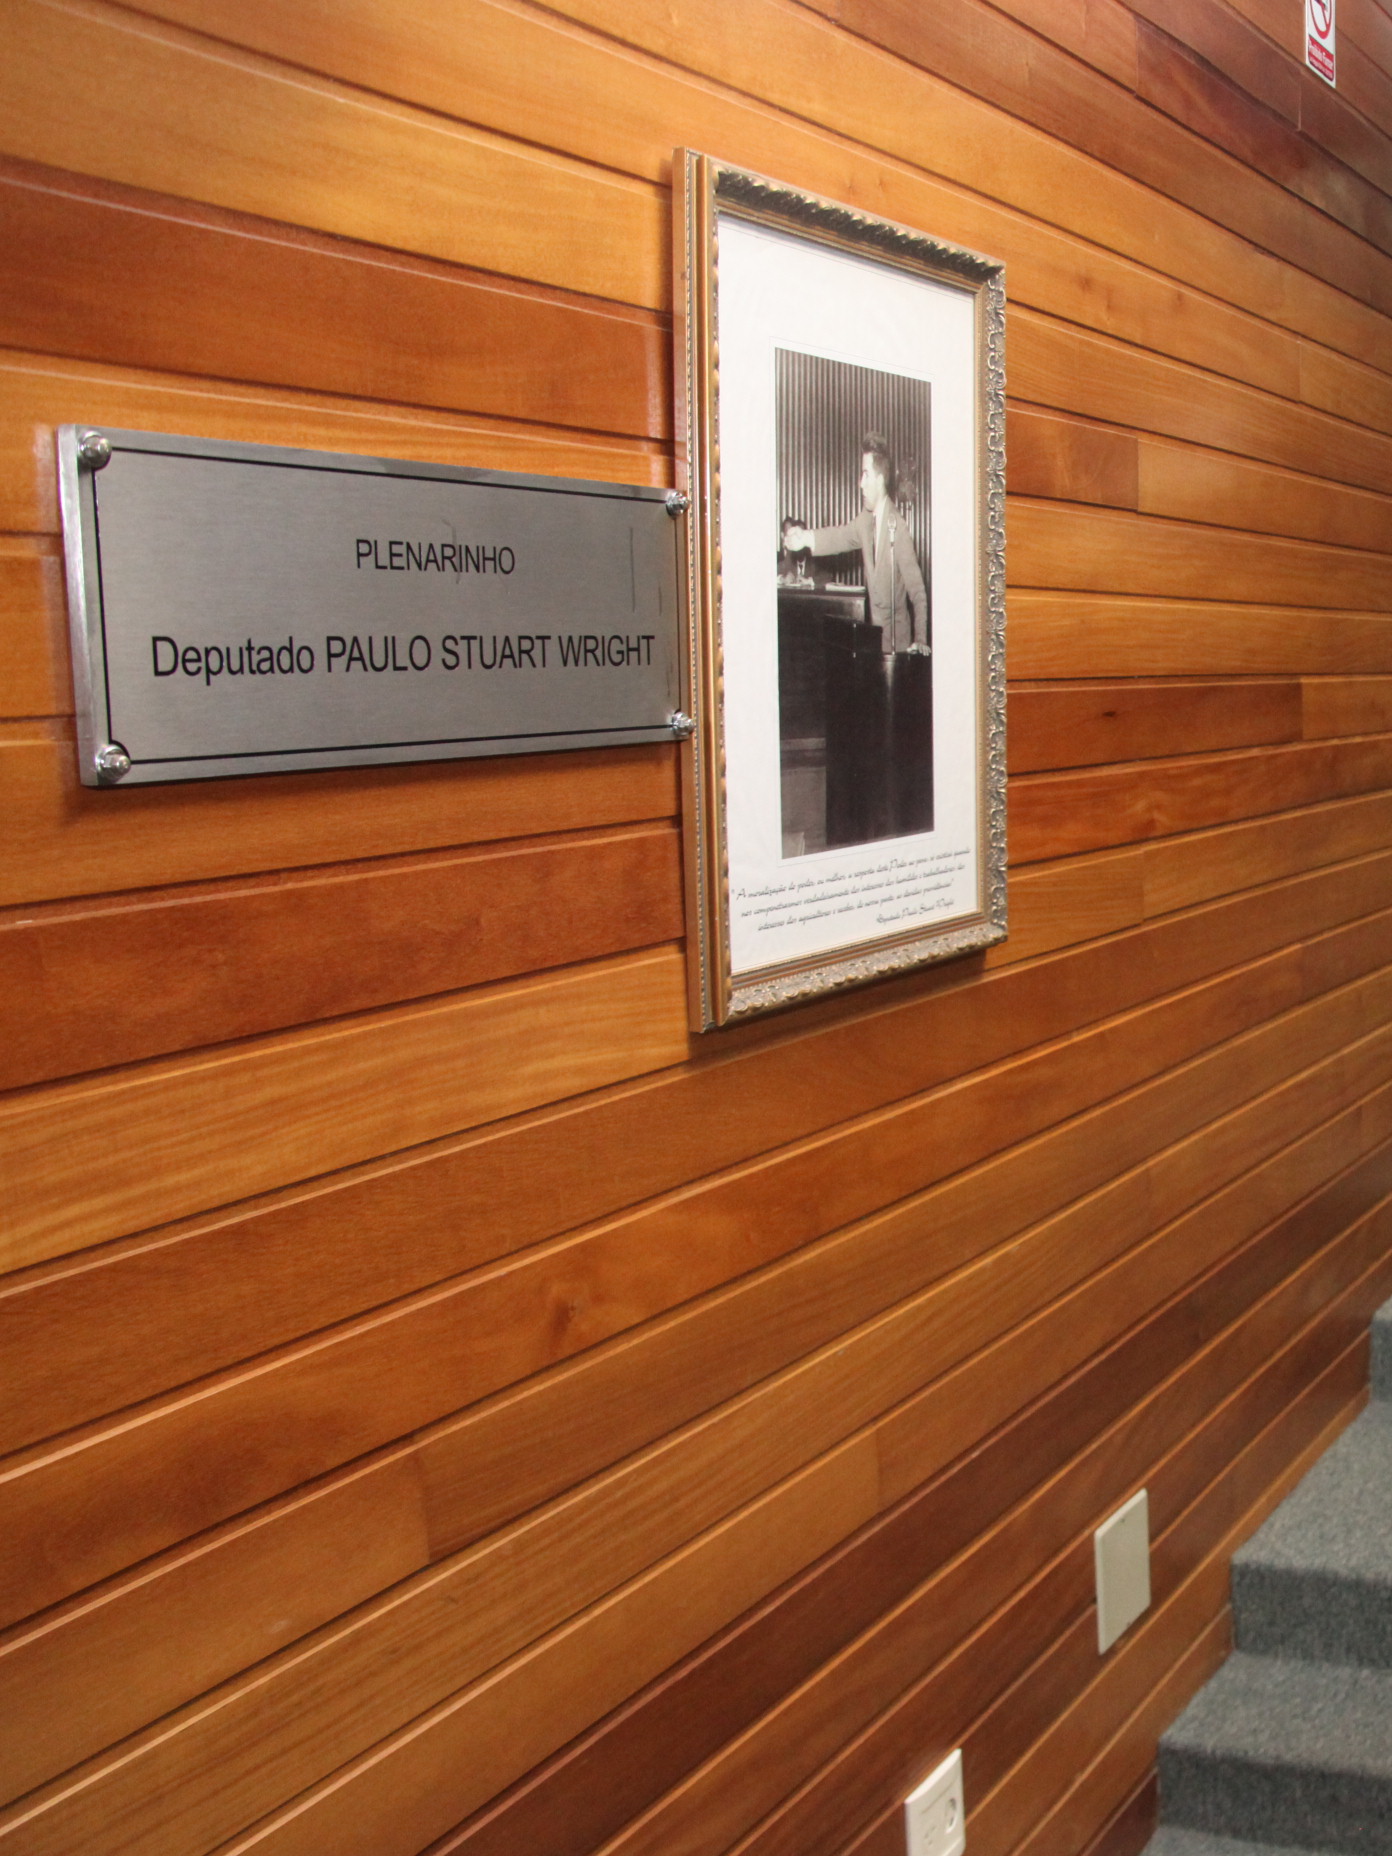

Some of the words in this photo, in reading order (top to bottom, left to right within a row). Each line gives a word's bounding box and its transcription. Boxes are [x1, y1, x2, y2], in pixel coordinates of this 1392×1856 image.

[356, 539, 516, 575] PLENARINHO
[152, 635, 315, 686] Deputado
[326, 635, 432, 672] PAULO
[441, 634, 552, 671] STUART
[558, 634, 656, 667] WRIGHT
